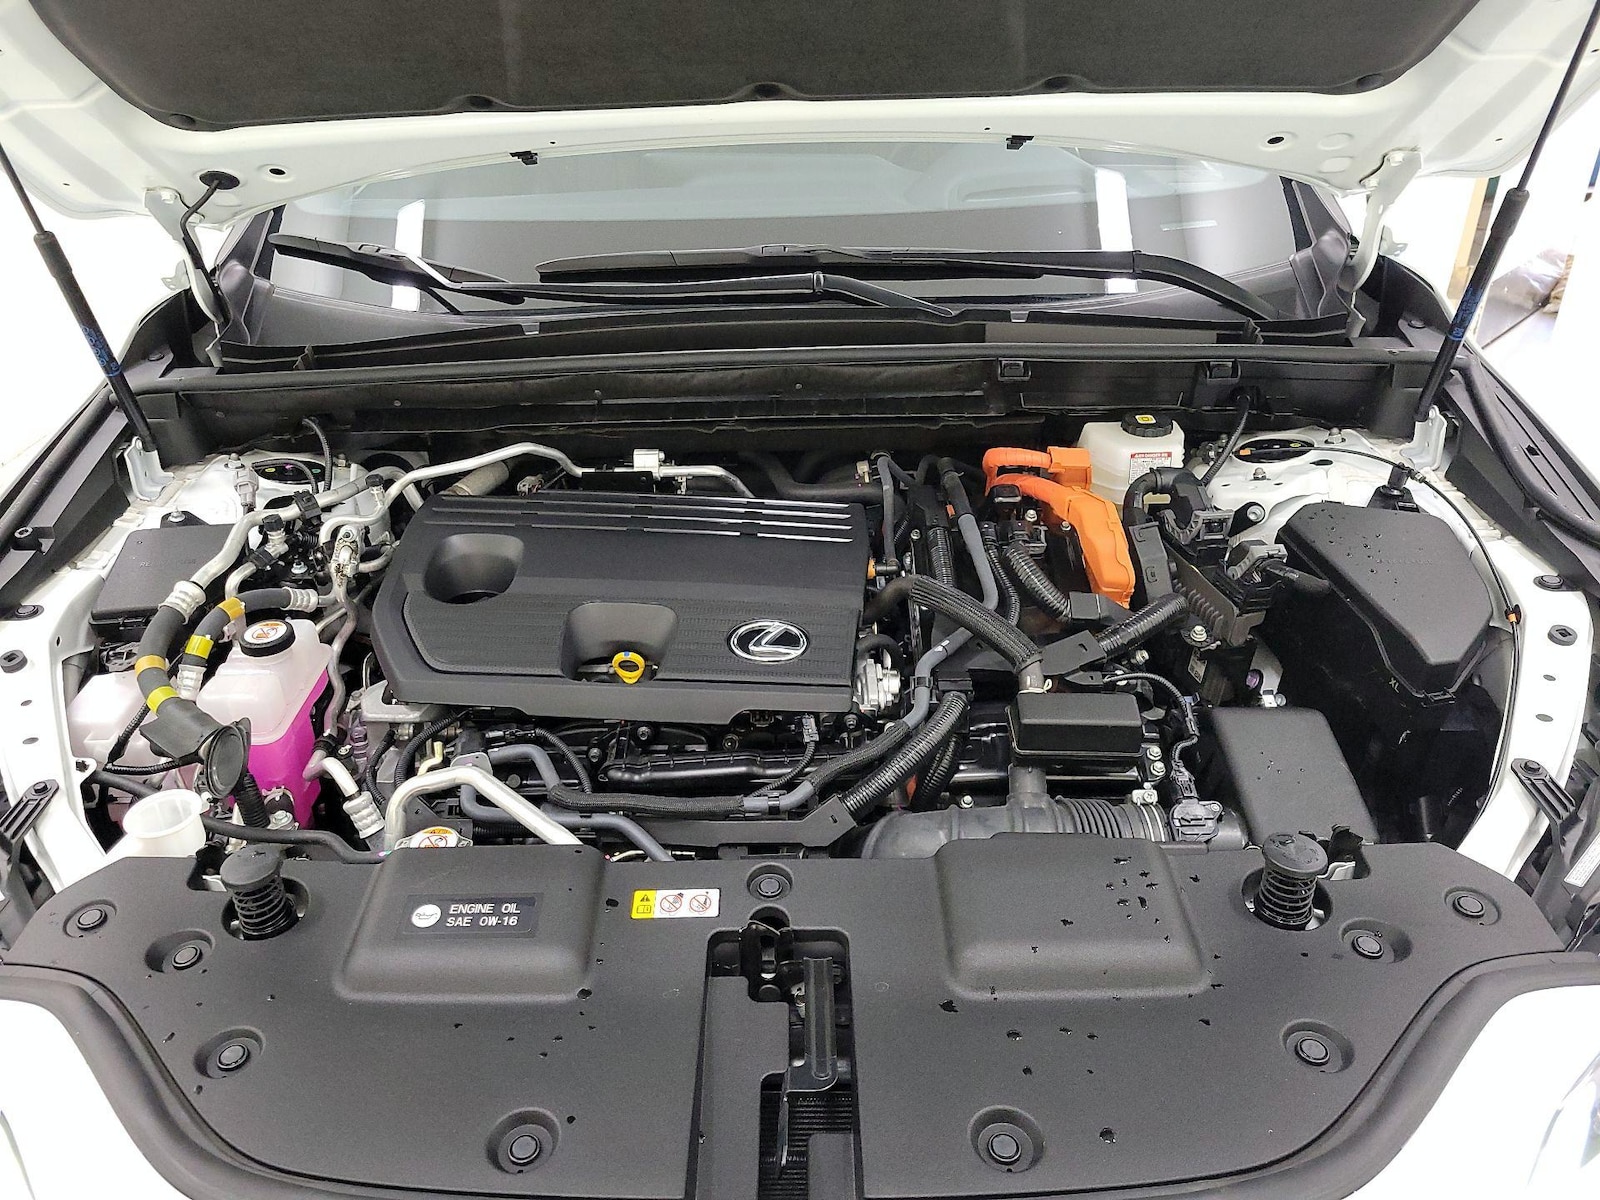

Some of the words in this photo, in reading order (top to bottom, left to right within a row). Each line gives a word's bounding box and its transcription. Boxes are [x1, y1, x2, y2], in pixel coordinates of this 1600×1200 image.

[449, 903, 494, 914] ENGINE
[501, 903, 521, 914] OIL
[446, 916, 473, 927] SAE
[479, 916, 518, 927] 0W-16
